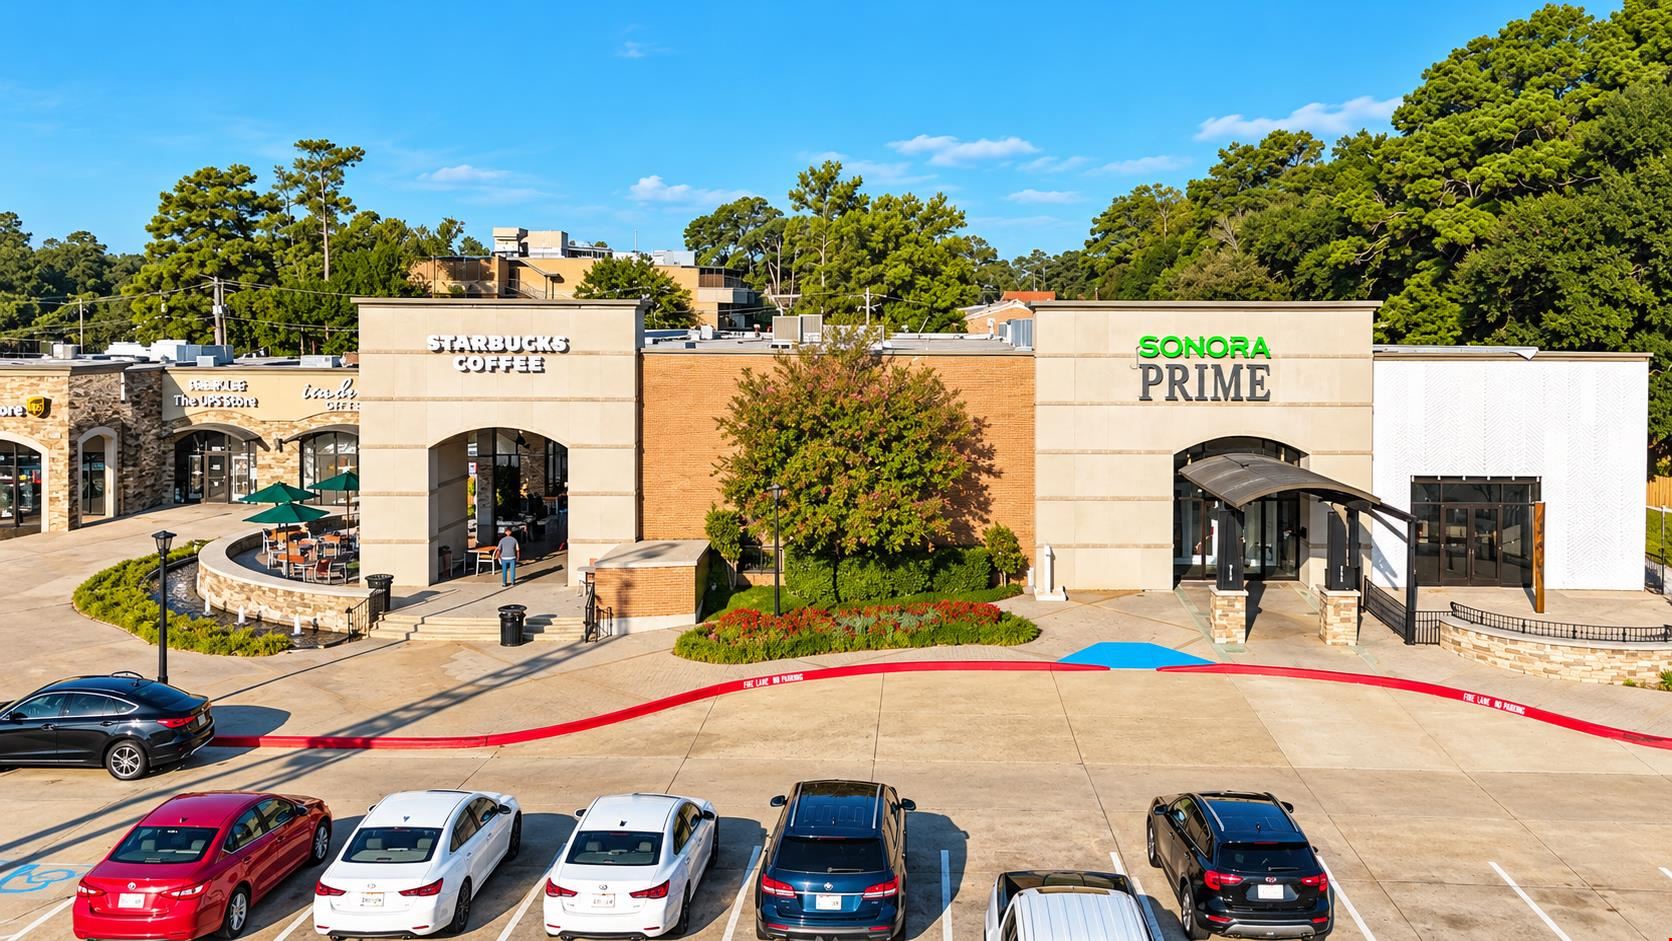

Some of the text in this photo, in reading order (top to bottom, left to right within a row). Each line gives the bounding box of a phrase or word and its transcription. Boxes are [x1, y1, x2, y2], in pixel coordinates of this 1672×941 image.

[426, 335, 570, 353] STARBUCKS
[1139, 336, 1271, 358] SONORA
[453, 356, 545, 373] COFFEE
[1138, 364, 1271, 401] PRIME
[173, 394, 258, 408] The UPS Store
